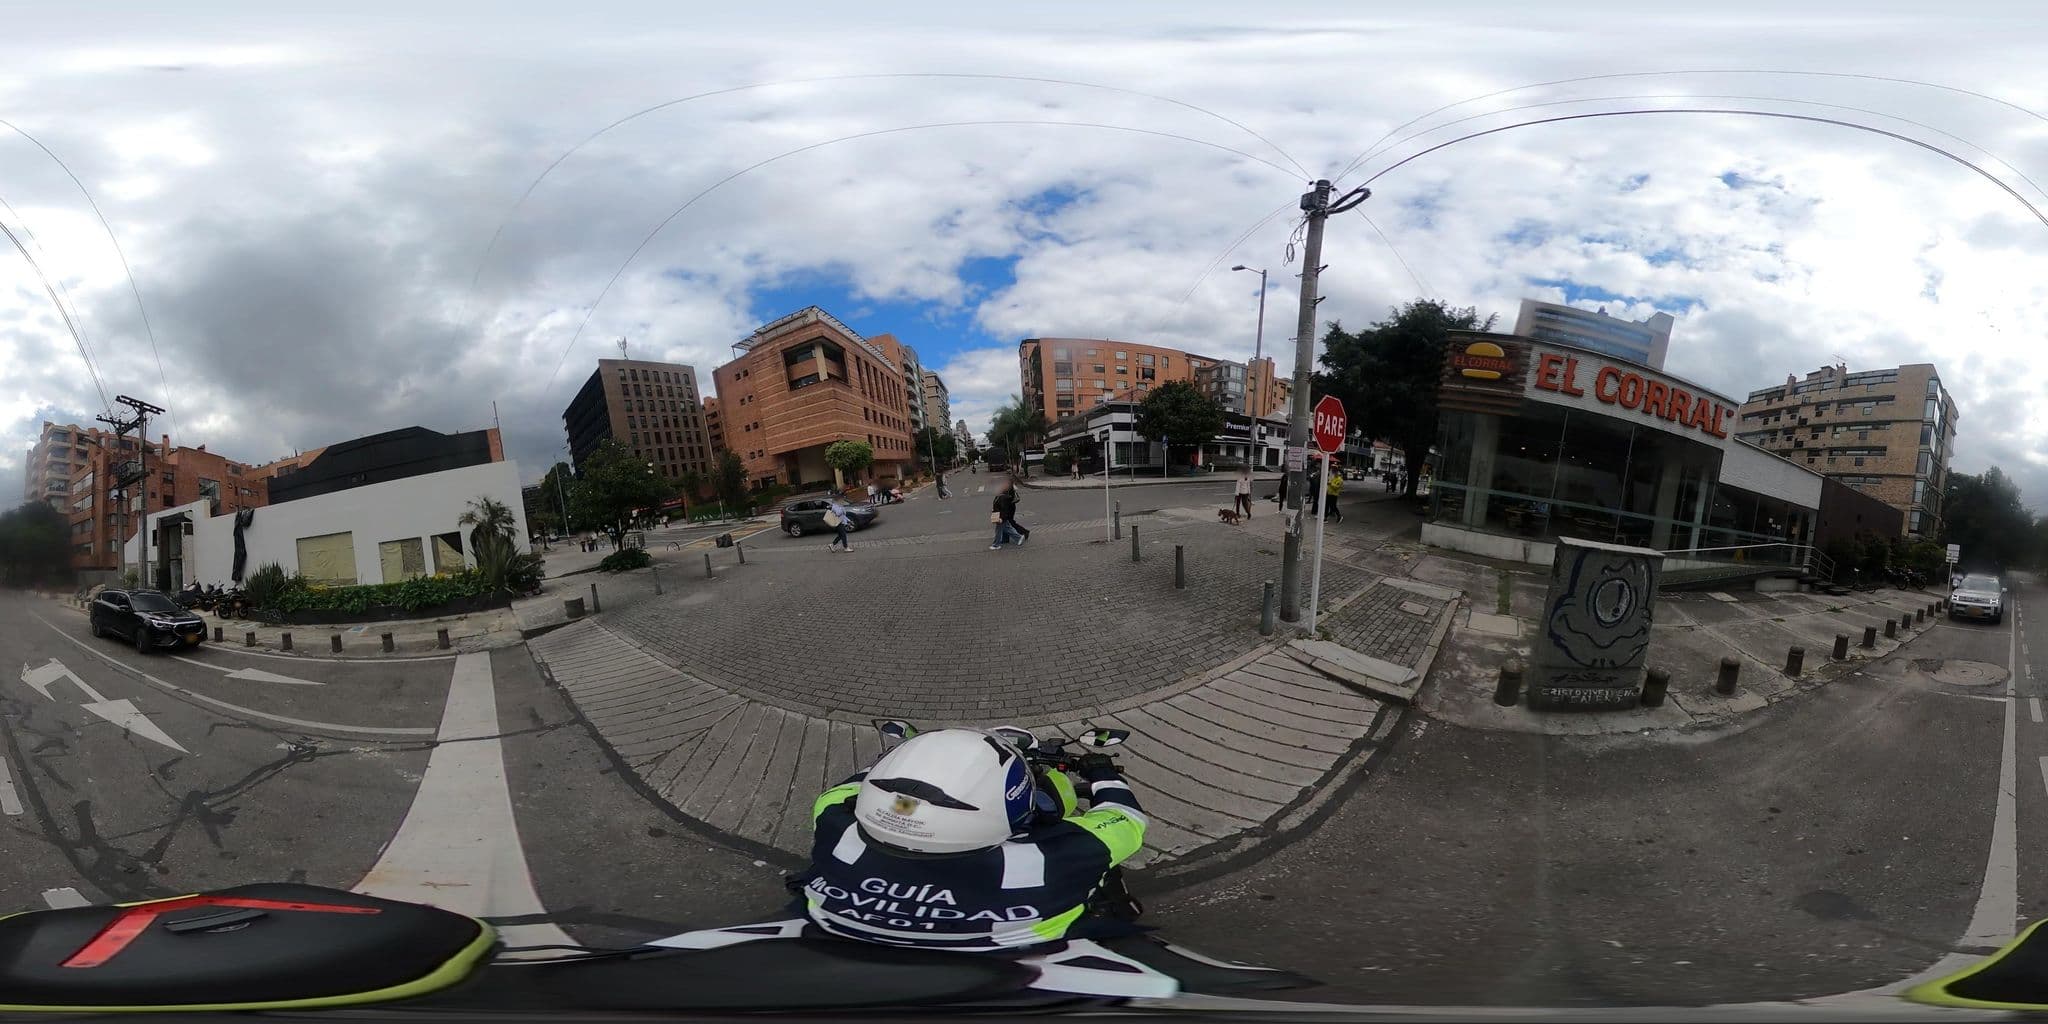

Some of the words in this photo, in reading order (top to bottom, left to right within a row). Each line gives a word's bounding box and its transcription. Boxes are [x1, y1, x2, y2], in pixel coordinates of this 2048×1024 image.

[1454, 356, 1467, 366] EL
[1468, 357, 1513, 369] CORRAL
[1535, 353, 1584, 397] EL
[1595, 365, 1728, 439] CORRAL
[1317, 411, 1344, 437] PARE
[810, 876, 1040, 922] MOVILIDAD
[860, 877, 958, 906] GUÍA
